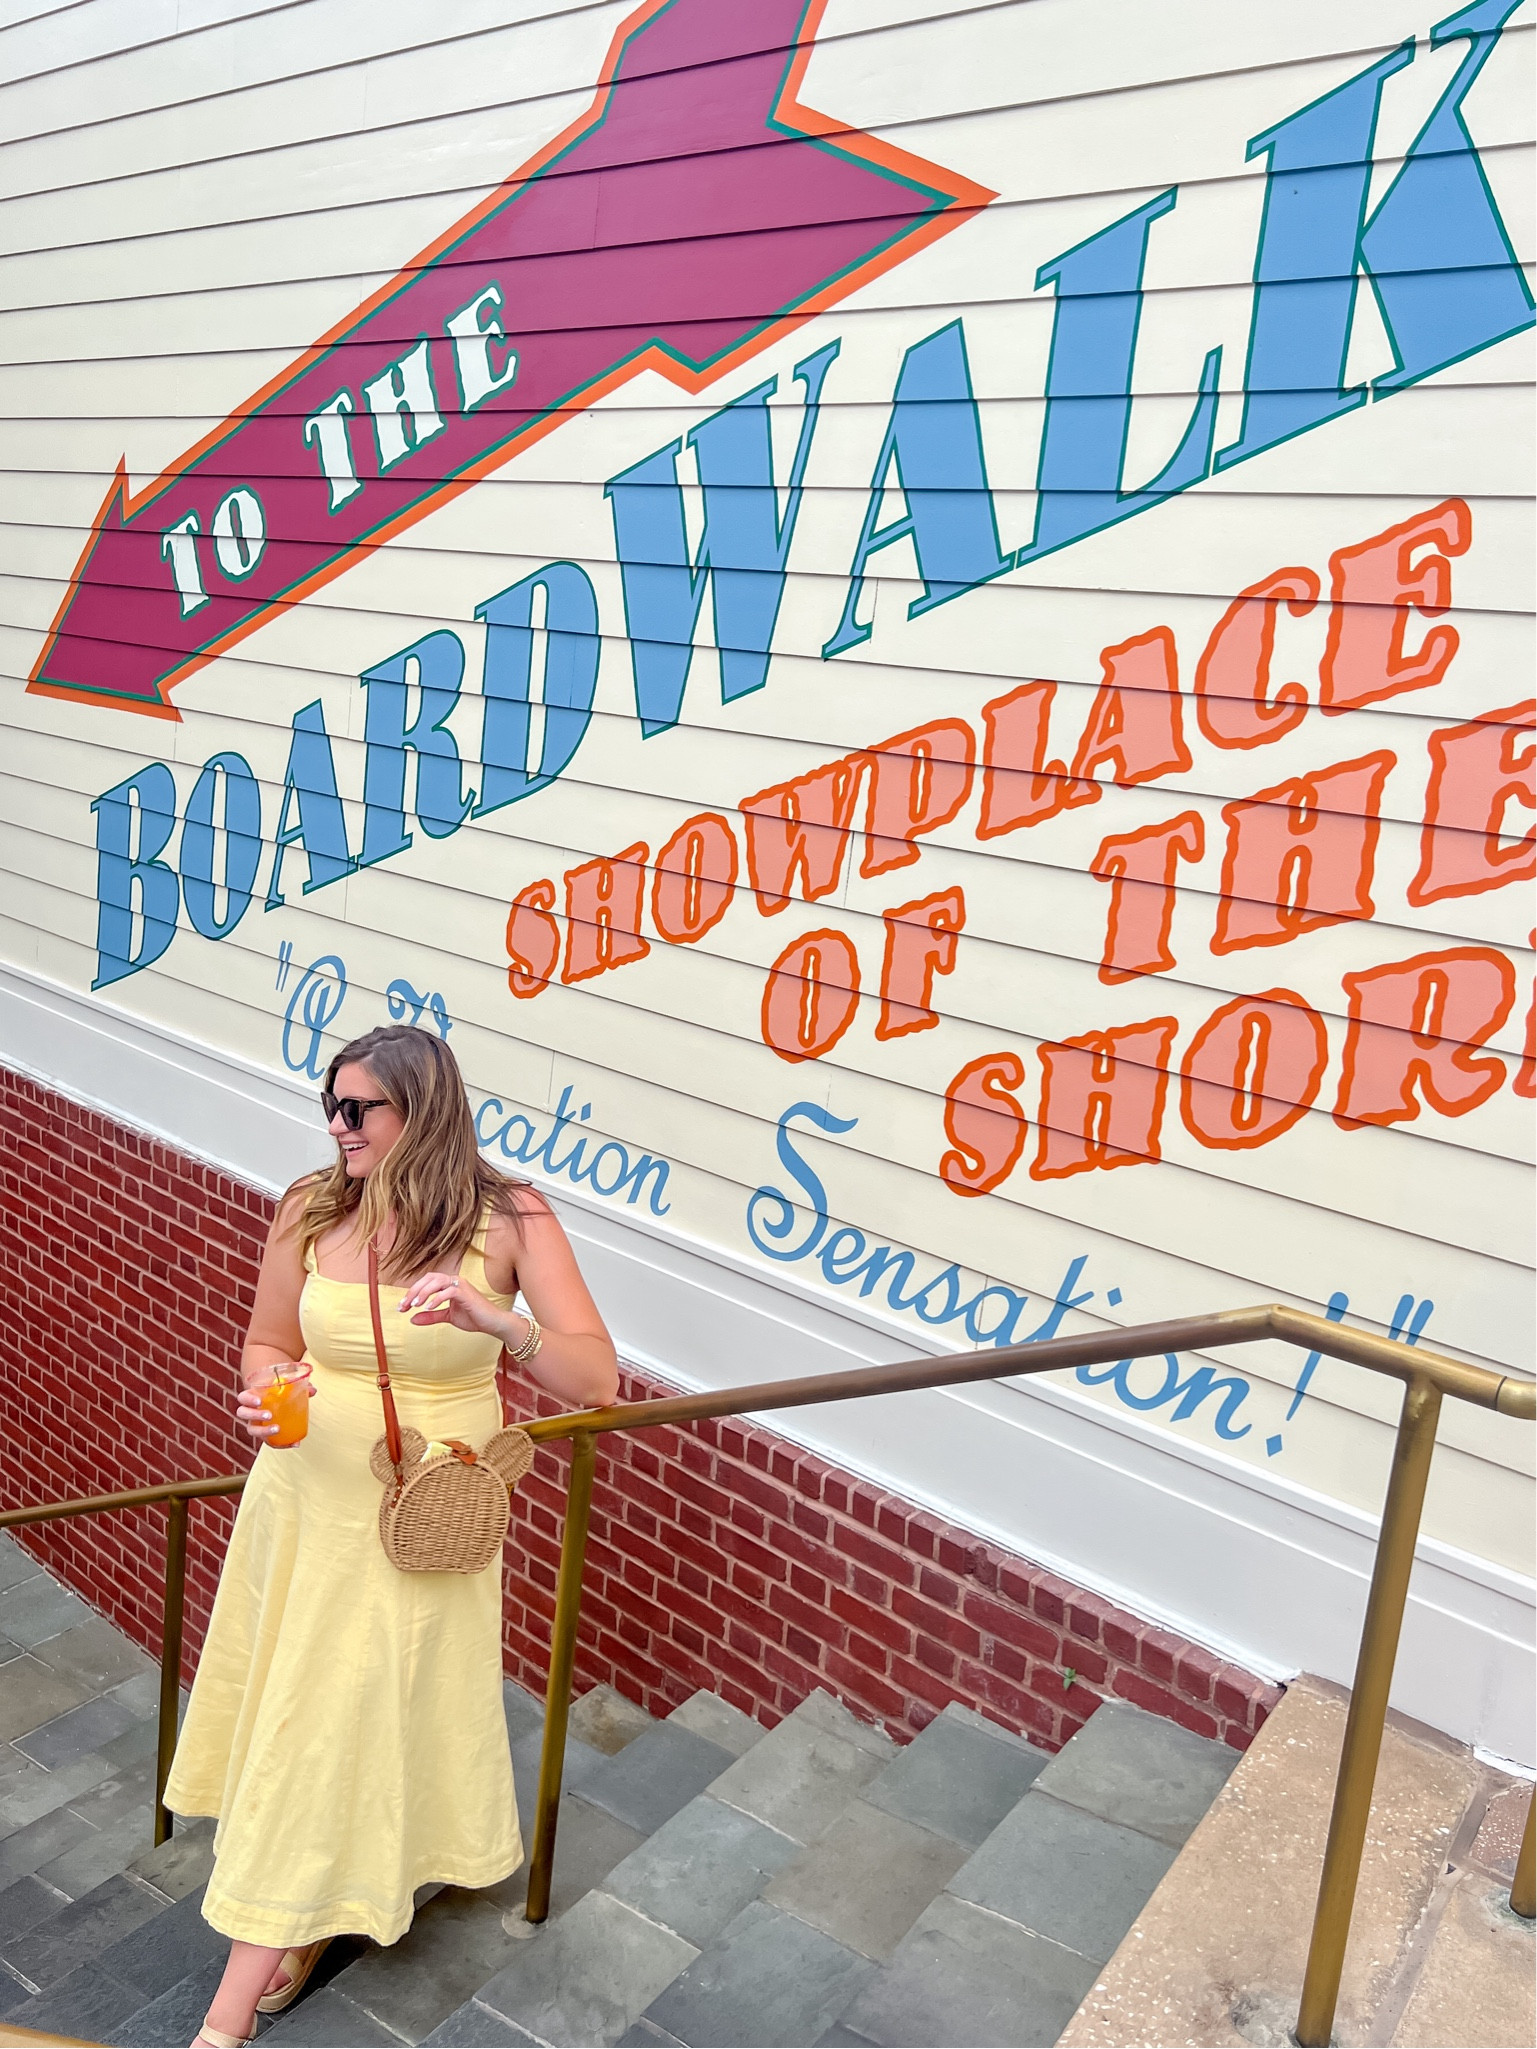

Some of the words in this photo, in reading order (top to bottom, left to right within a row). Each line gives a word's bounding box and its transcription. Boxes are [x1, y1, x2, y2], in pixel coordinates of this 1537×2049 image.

[91, 0, 1537, 991] BOARDWALK
[160, 486, 268, 618] TO
[303, 280, 520, 516] THE
[505, 498, 1472, 1000] SHOWPLACE
[761, 885, 967, 1064] OF
[1089, 698, 1537, 986] THE
[386, 978, 672, 1217] cation
[938, 926, 1537, 1199] SHOR
